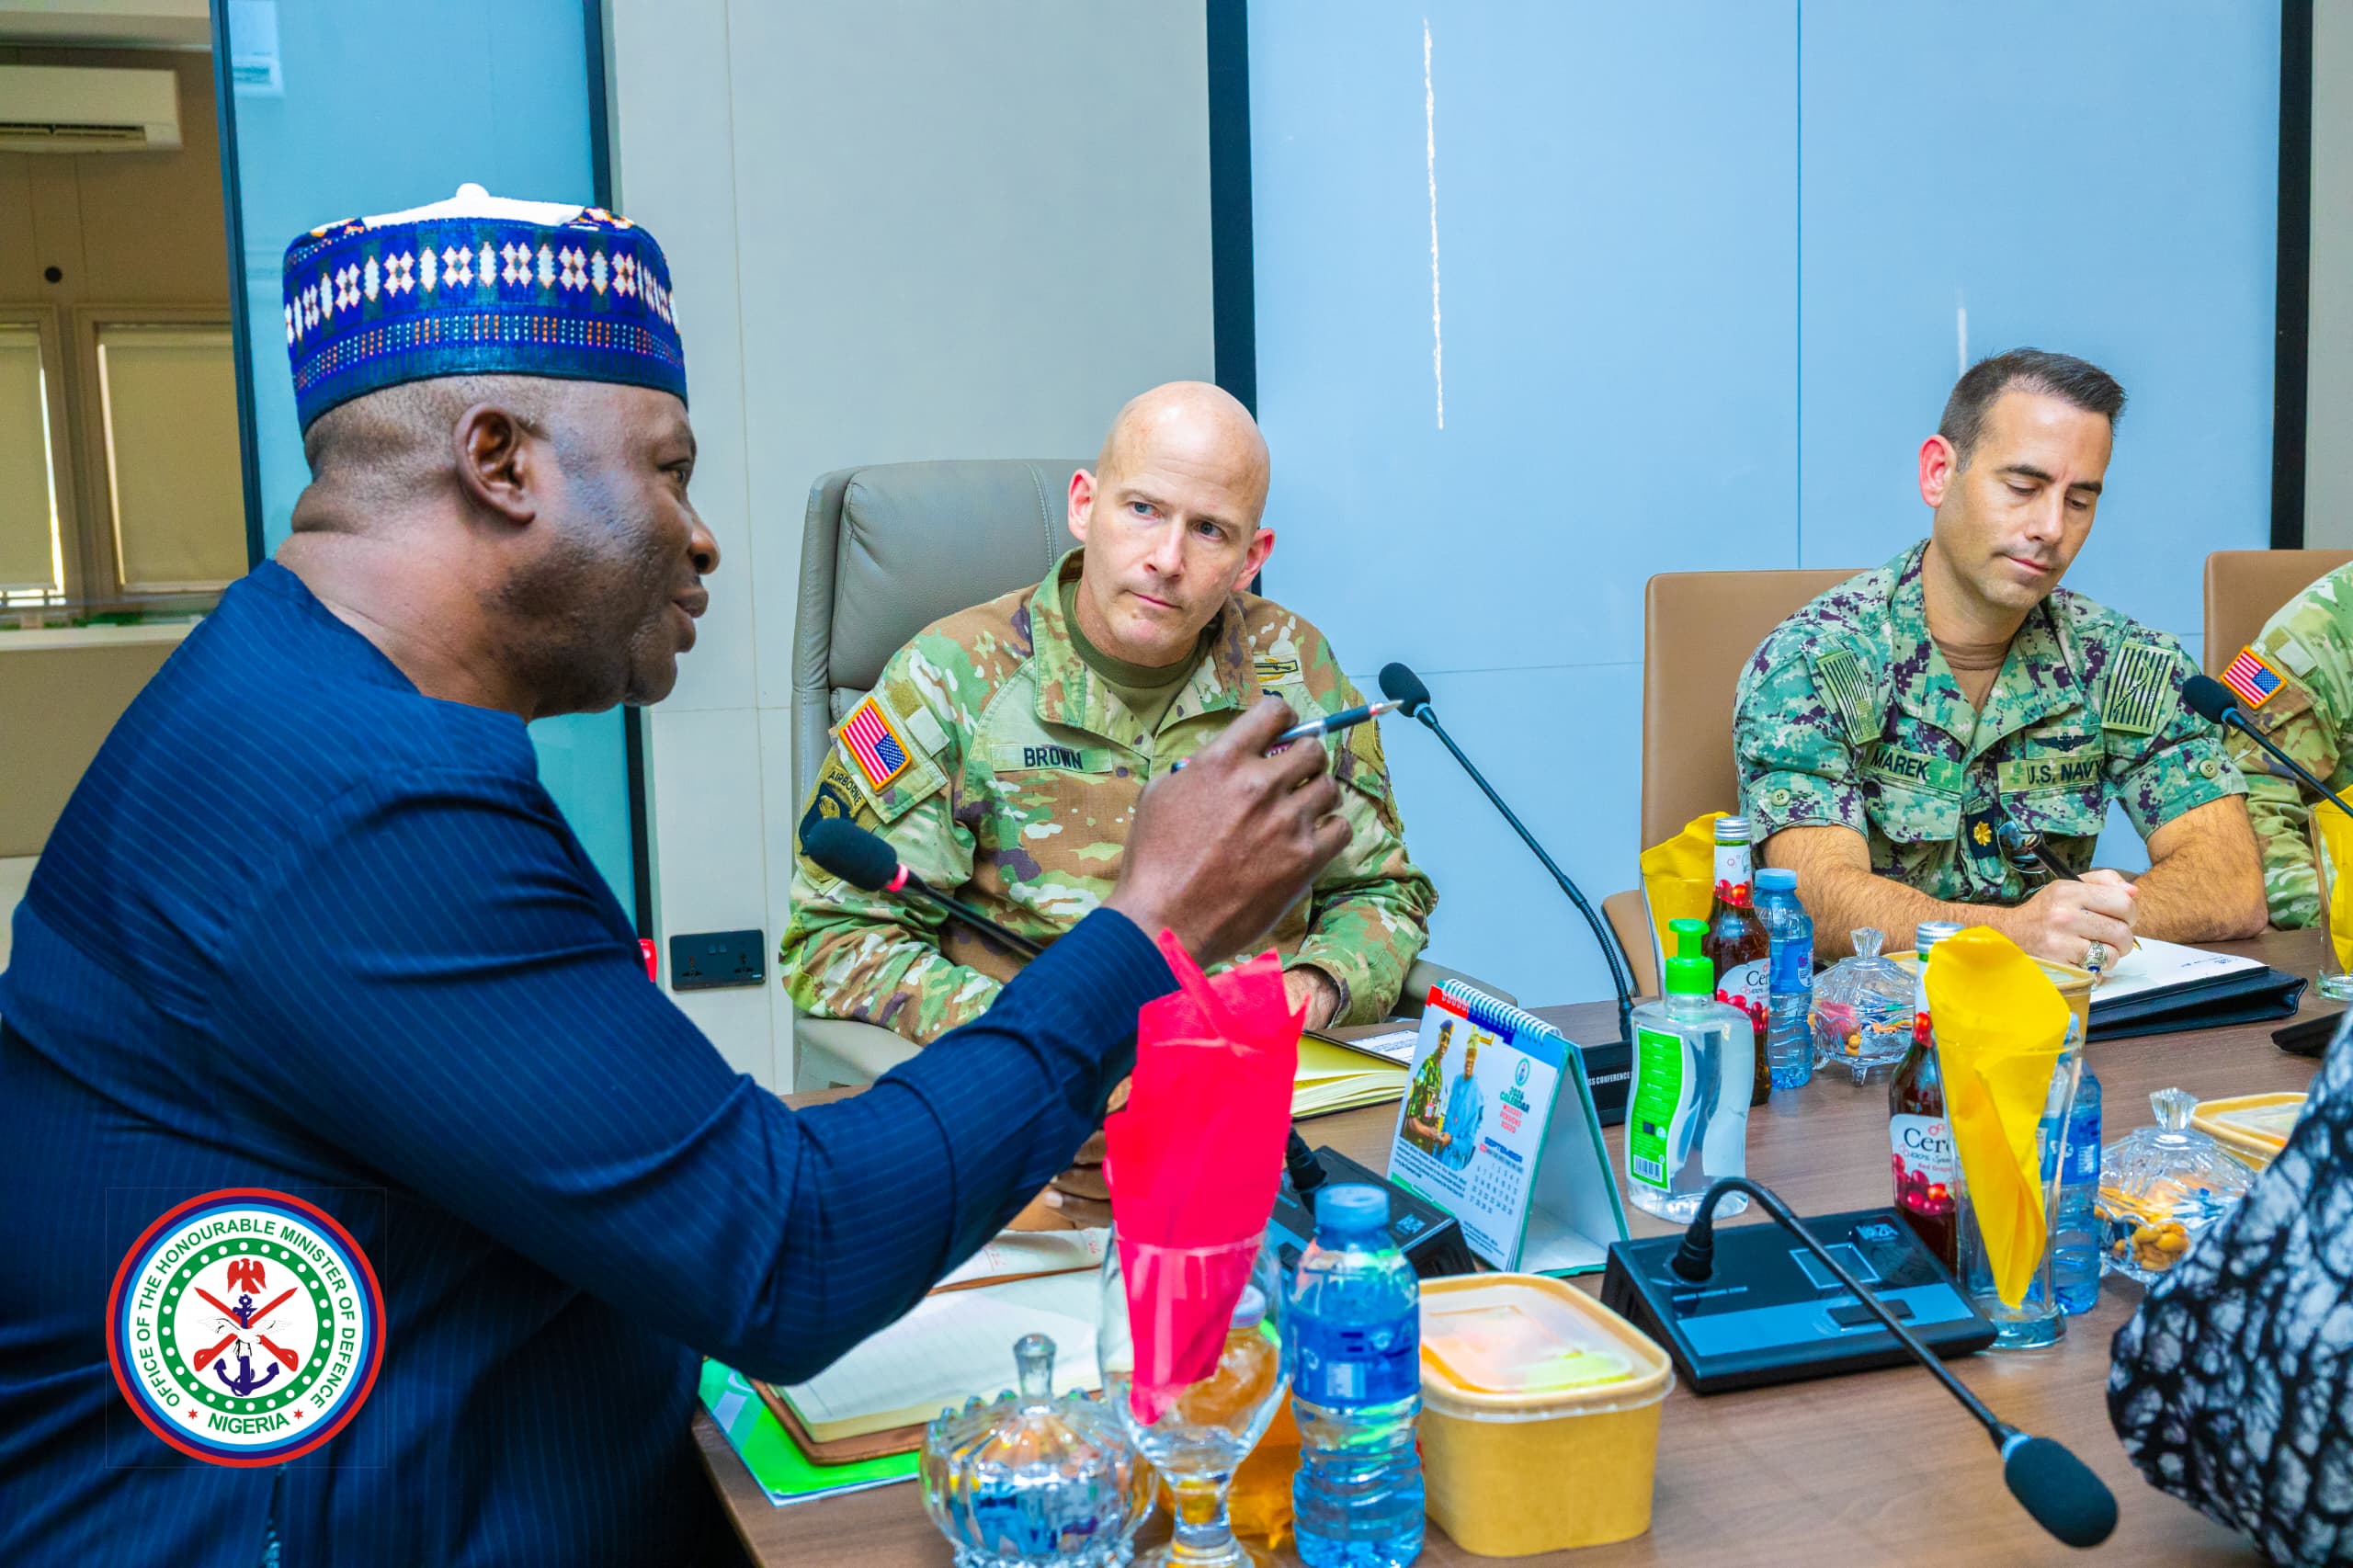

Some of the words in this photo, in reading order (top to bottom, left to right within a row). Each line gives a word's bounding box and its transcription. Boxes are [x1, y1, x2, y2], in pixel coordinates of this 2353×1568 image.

[1024, 747, 1083, 770] BROWN
[1870, 748, 1930, 780] MAREK
[2027, 765, 2056, 784] U.S.
[2061, 759, 2103, 781] NAVY
[827, 770, 862, 807] AIRBORNE
[1596, 1072, 1631, 1085] CONFERENCE
